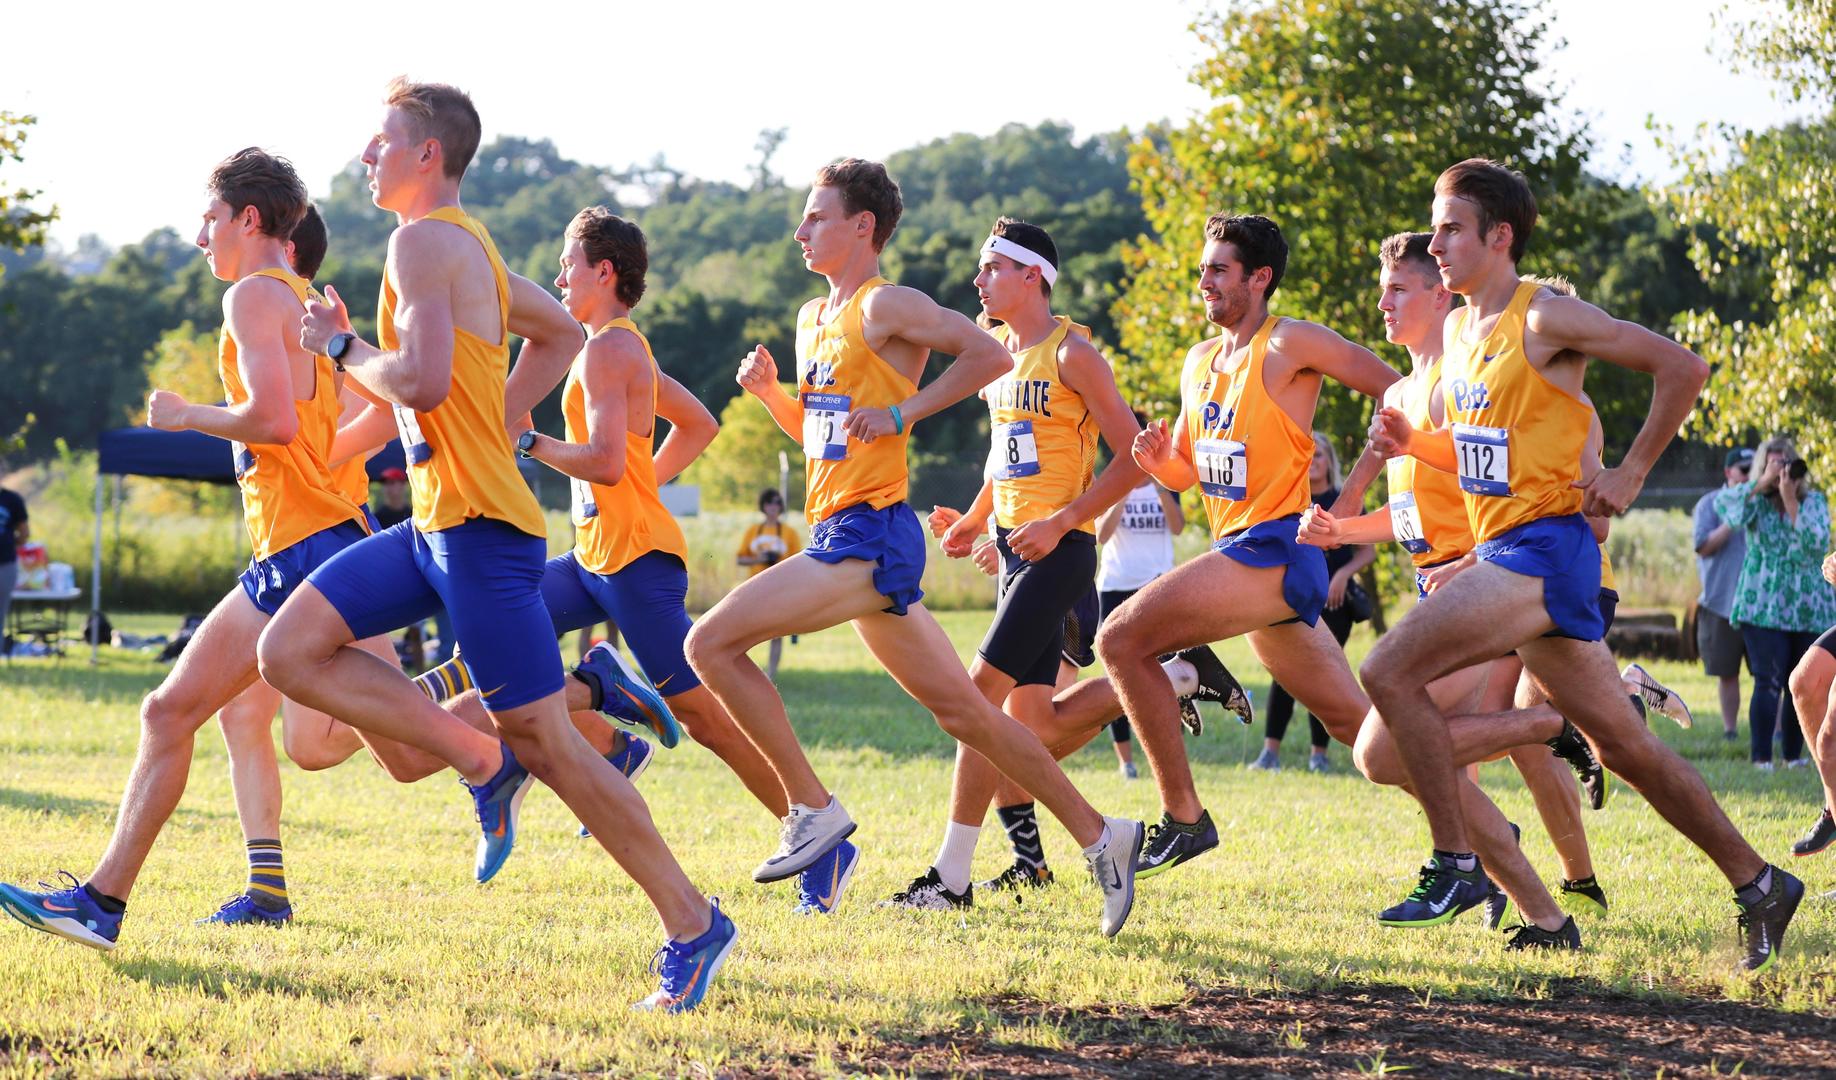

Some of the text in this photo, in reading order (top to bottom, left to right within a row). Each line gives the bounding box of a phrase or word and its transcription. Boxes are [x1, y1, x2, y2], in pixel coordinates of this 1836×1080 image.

[1007, 380, 1052, 418] STATE
[1450, 378, 1490, 412] Pitt
[808, 410, 835, 444] 15
[1004, 436, 1020, 465] 8
[1461, 442, 1495, 481] 112
[1205, 454, 1234, 486] 118
[1121, 516, 1166, 529] LASHE
[1124, 502, 1165, 514] OLDEN
[1393, 509, 1416, 541] 116
